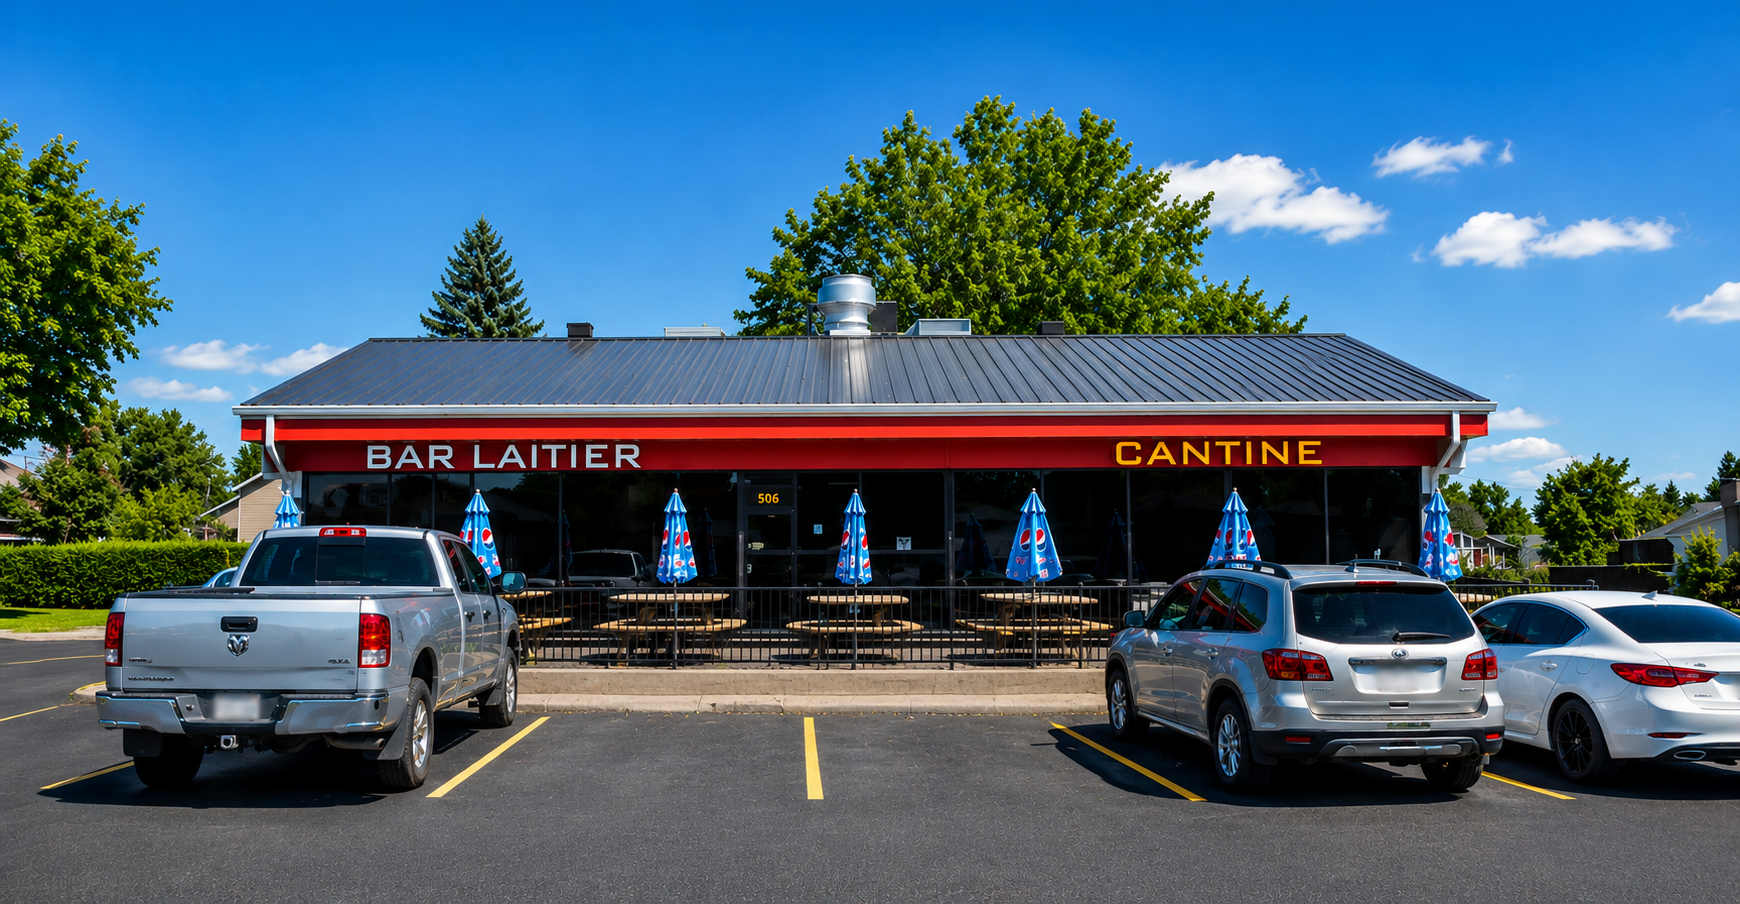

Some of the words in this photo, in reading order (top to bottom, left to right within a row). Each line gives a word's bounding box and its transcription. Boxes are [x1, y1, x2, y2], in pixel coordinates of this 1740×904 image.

[367, 445, 454, 469] BAR
[474, 445, 640, 468] LAITIER
[1116, 441, 1322, 465] CANTINE
[758, 493, 779, 504] 506
